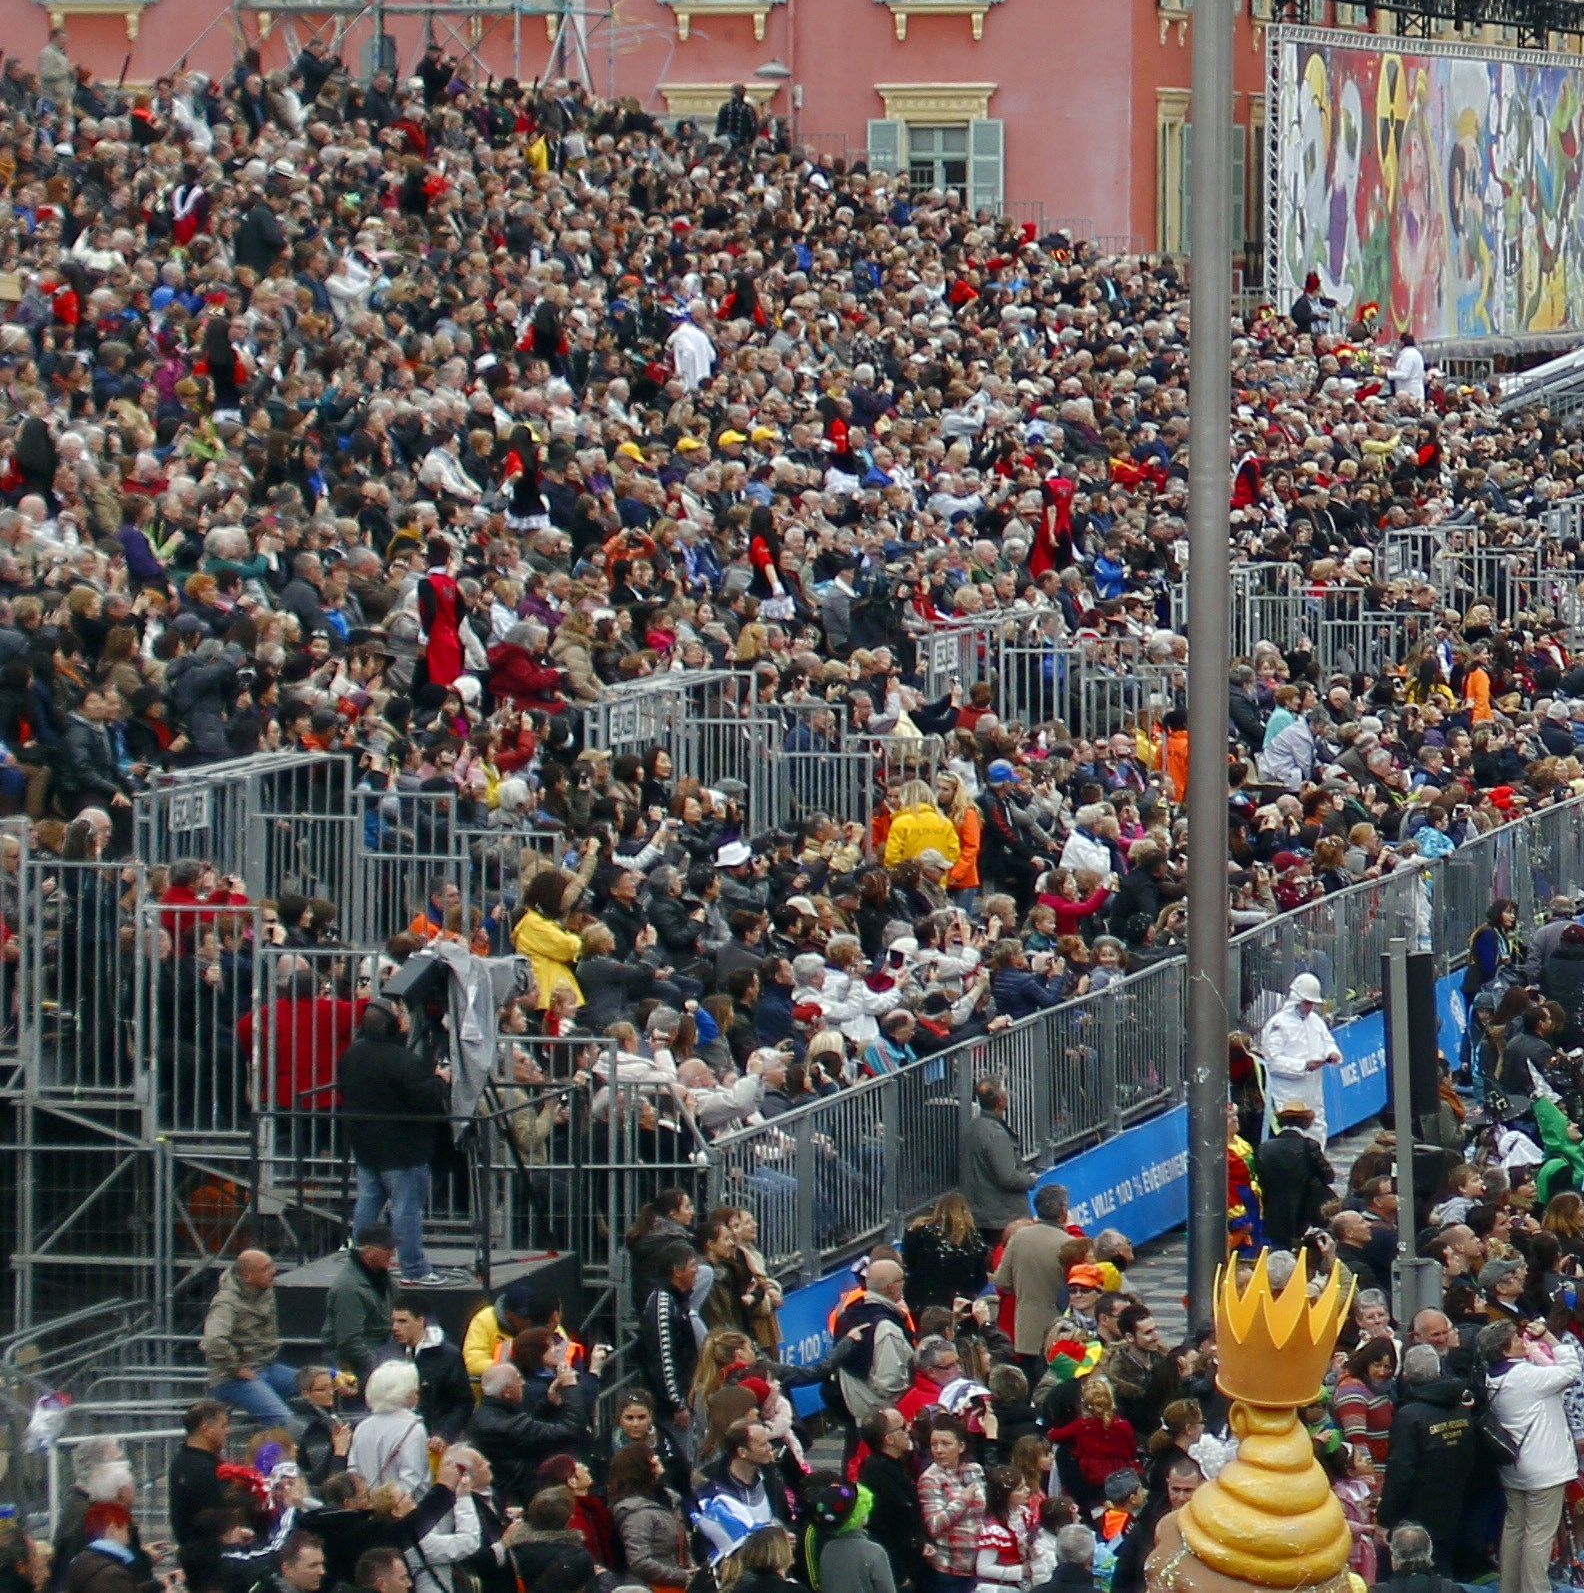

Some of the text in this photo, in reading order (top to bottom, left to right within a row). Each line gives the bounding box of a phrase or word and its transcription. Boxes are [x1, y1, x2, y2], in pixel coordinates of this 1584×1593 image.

[1091, 1188, 1116, 1219] VILLE
[1115, 1179, 1133, 1206] 100
[798, 1333, 821, 1365] 100
